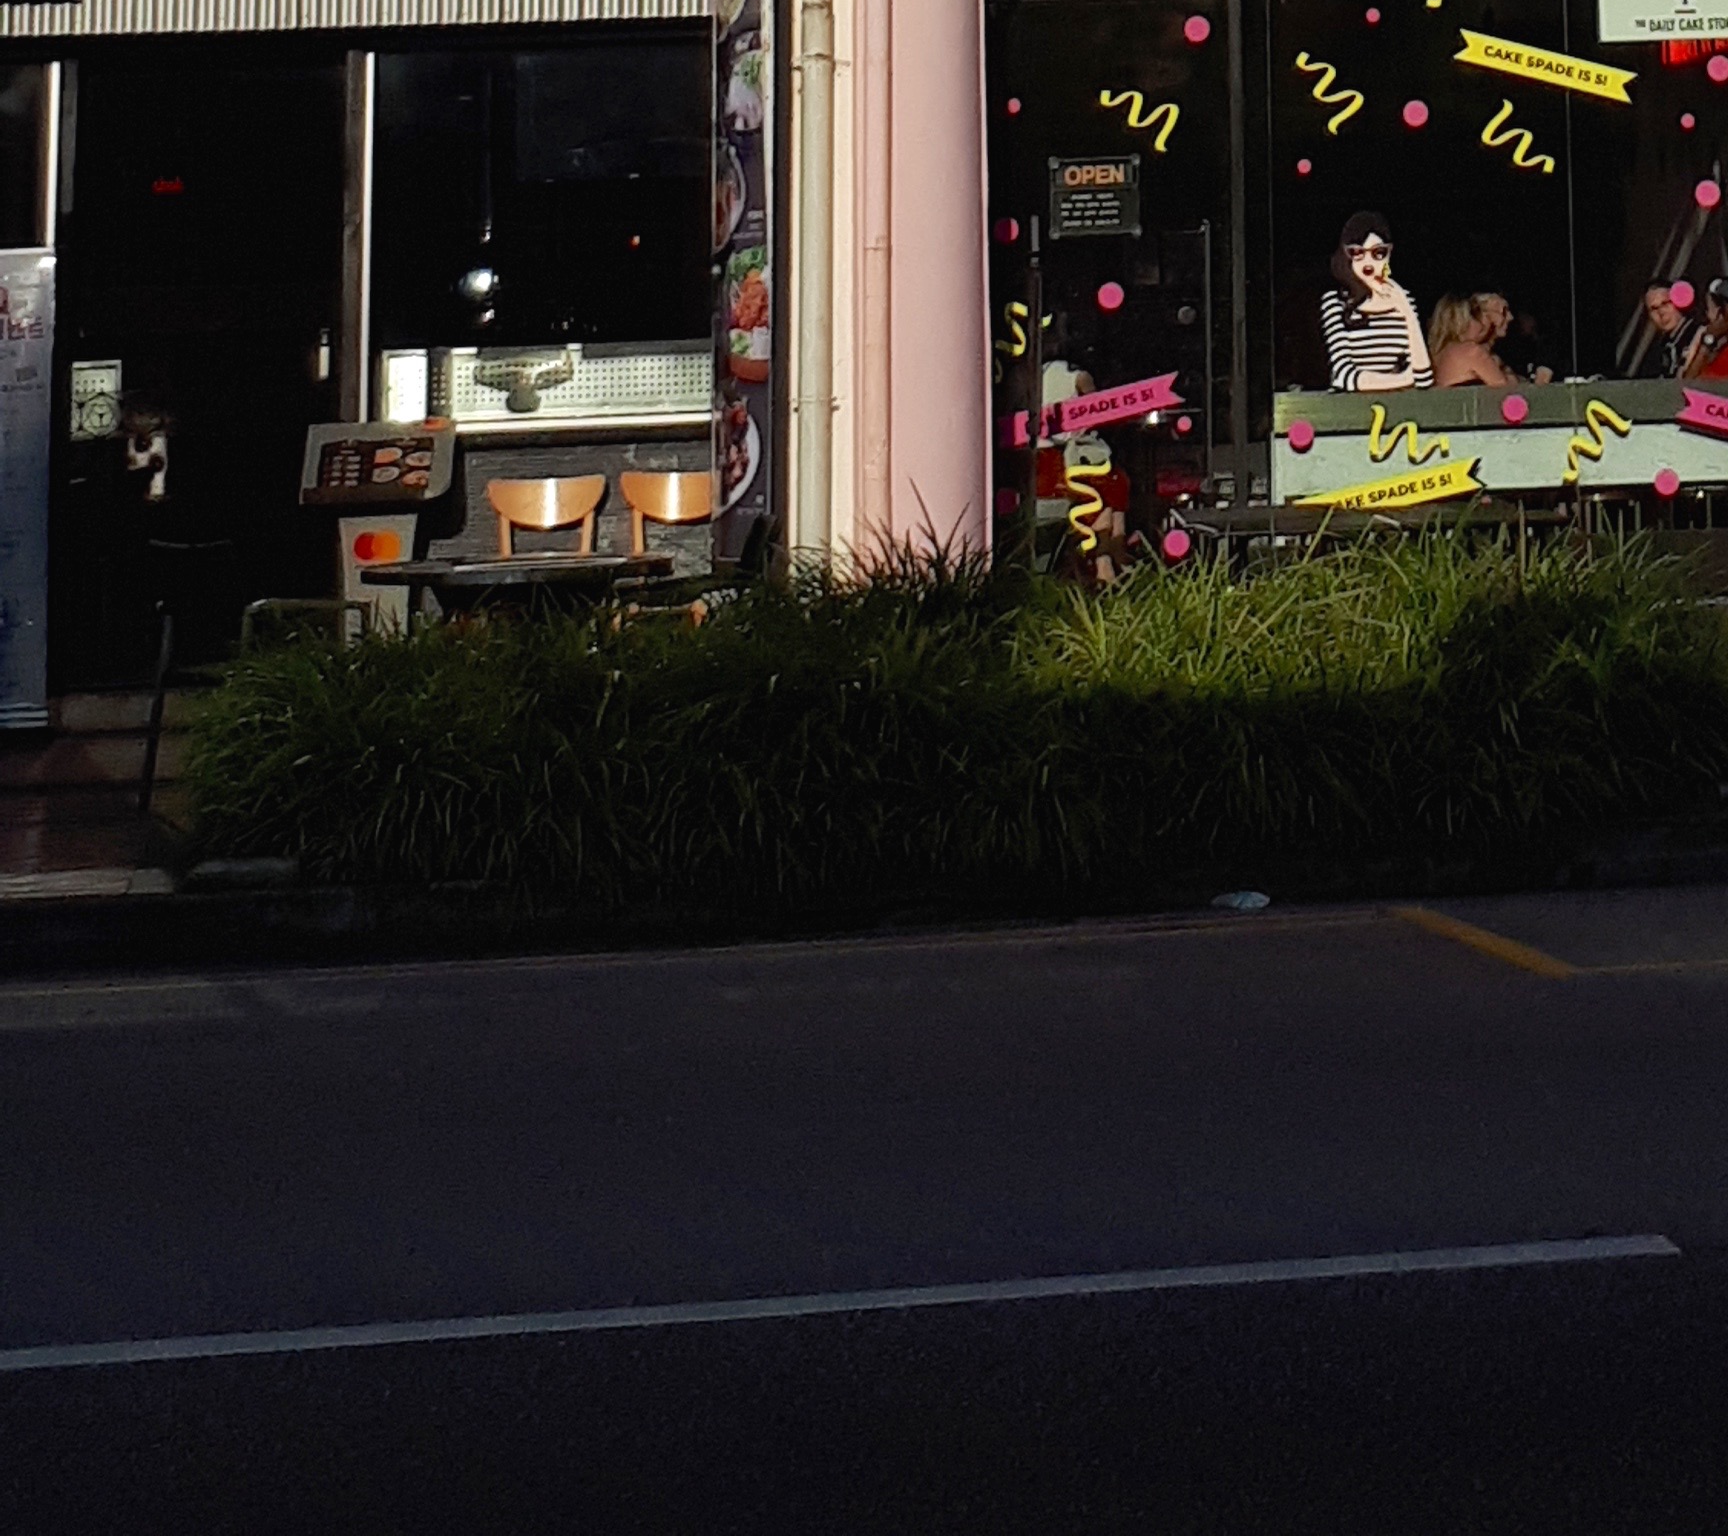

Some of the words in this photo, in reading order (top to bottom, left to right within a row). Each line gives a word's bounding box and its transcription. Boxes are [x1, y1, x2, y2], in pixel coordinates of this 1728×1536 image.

[1679, 17, 1705, 32] CAKE
[1484, 44, 1523, 64] CAKE
[1526, 54, 1575, 77] SPADE
[1577, 69, 1592, 84] IS
[1063, 162, 1126, 187] OPEN
[1068, 396, 1120, 421] SPADE
[1122, 392, 1137, 406] IS
[1368, 482, 1418, 504] SPADE
[1421, 478, 1436, 492] IS
